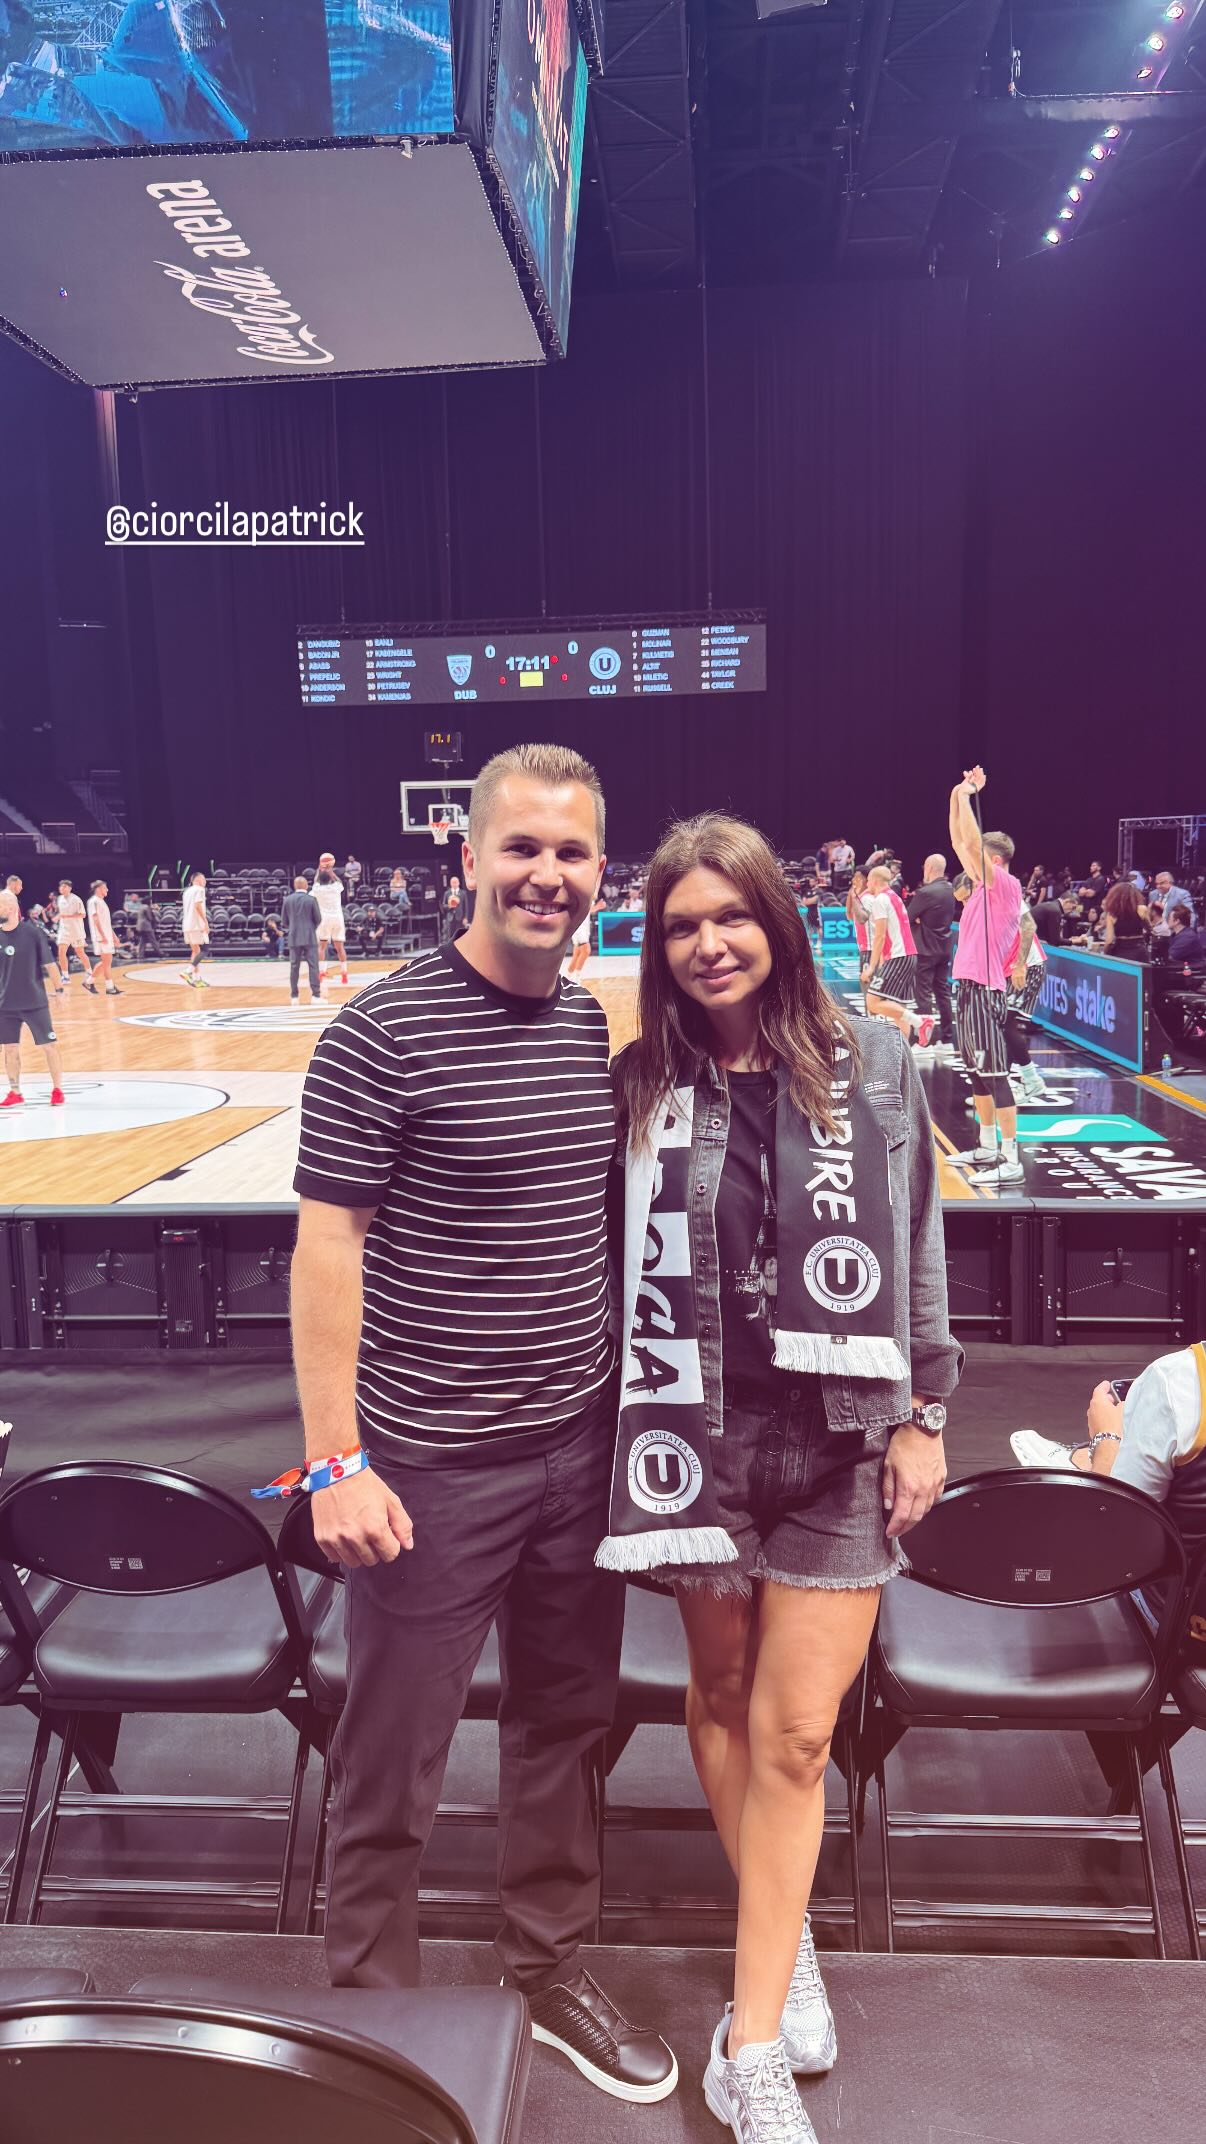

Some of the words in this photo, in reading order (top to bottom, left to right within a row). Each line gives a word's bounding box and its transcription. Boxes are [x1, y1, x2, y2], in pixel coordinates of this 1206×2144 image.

[146, 179, 251, 259] arena
[484, 644, 496, 659] 0
[567, 640, 579, 655] 0
[506, 656, 550, 671] 17:11
[454, 690, 478, 700] DUB
[588, 684, 617, 695] CLUJ
[1039, 974, 1068, 1016] UTES
[1075, 975, 1117, 1034] stake
[810, 1237, 870, 1259] UNIVERSITATEA
[868, 1258, 879, 1279] CLUJ
[824, 1258, 860, 1296] U
[830, 1303, 855, 1312] 1919
[630, 1432, 688, 1458] UNIVERSITATEA
[688, 1453, 700, 1474] CLUJ
[644, 1454, 682, 1494] U
[654, 1502, 680, 1512] 1919
